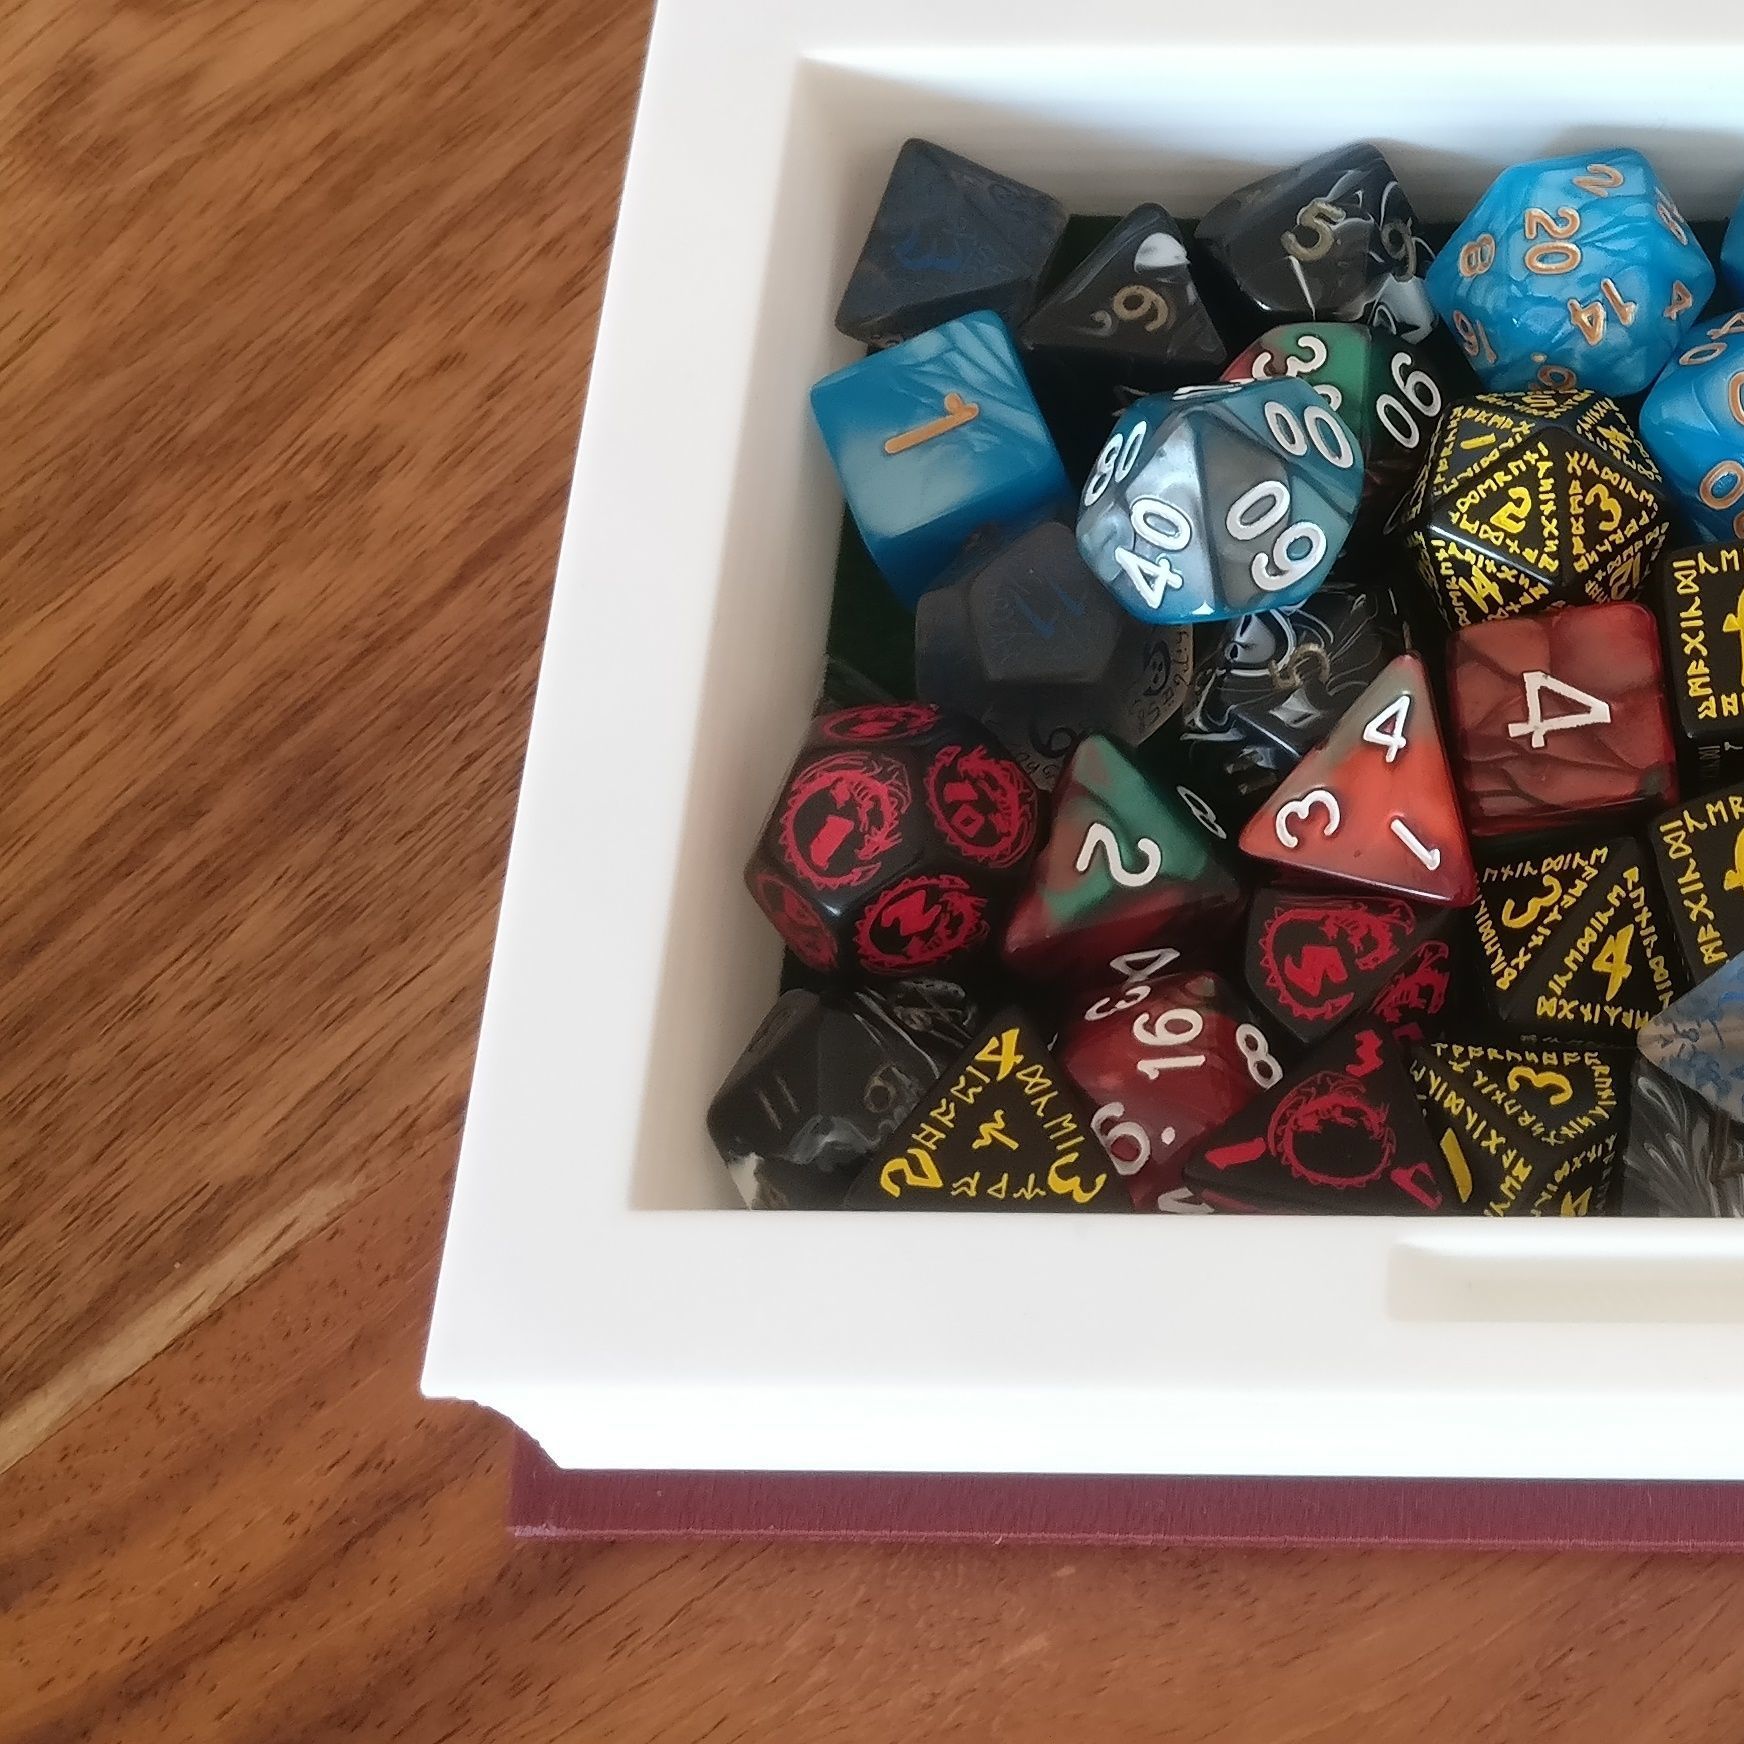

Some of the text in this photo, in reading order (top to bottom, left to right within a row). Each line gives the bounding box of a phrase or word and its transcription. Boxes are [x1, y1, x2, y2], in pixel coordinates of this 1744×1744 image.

[1572, 162, 1625, 198] 2
[1279, 200, 1347, 262] 5
[1458, 233, 1496, 279] 8
[1524, 206, 1583, 275] 20
[1567, 277, 1638, 346] 14
[1663, 279, 1694, 321] 4
[885, 392, 979, 454] 1
[1264, 400, 1354, 469] 00
[1083, 420, 1147, 506] 80
[1489, 486, 1532, 534] 2
[1584, 483, 1623, 532] 3
[1114, 496, 1192, 609] 40
[1362, 694, 1412, 763] 4
[1507, 670, 1612, 750] 4
[1275, 789, 1342, 849] 3
[1389, 817, 1442, 871] 1
[1074, 821, 1162, 888] 2
[1501, 873, 1564, 930] 3
[1592, 923, 1635, 1002] 4
[974, 1027, 1025, 1083] 4
[1132, 1006, 1207, 1081] 16
[1235, 1022, 1284, 1092] 8
[1506, 1065, 1574, 1106] 3
[879, 1147, 944, 1200] 2
[1046, 1152, 1108, 1204] 3
